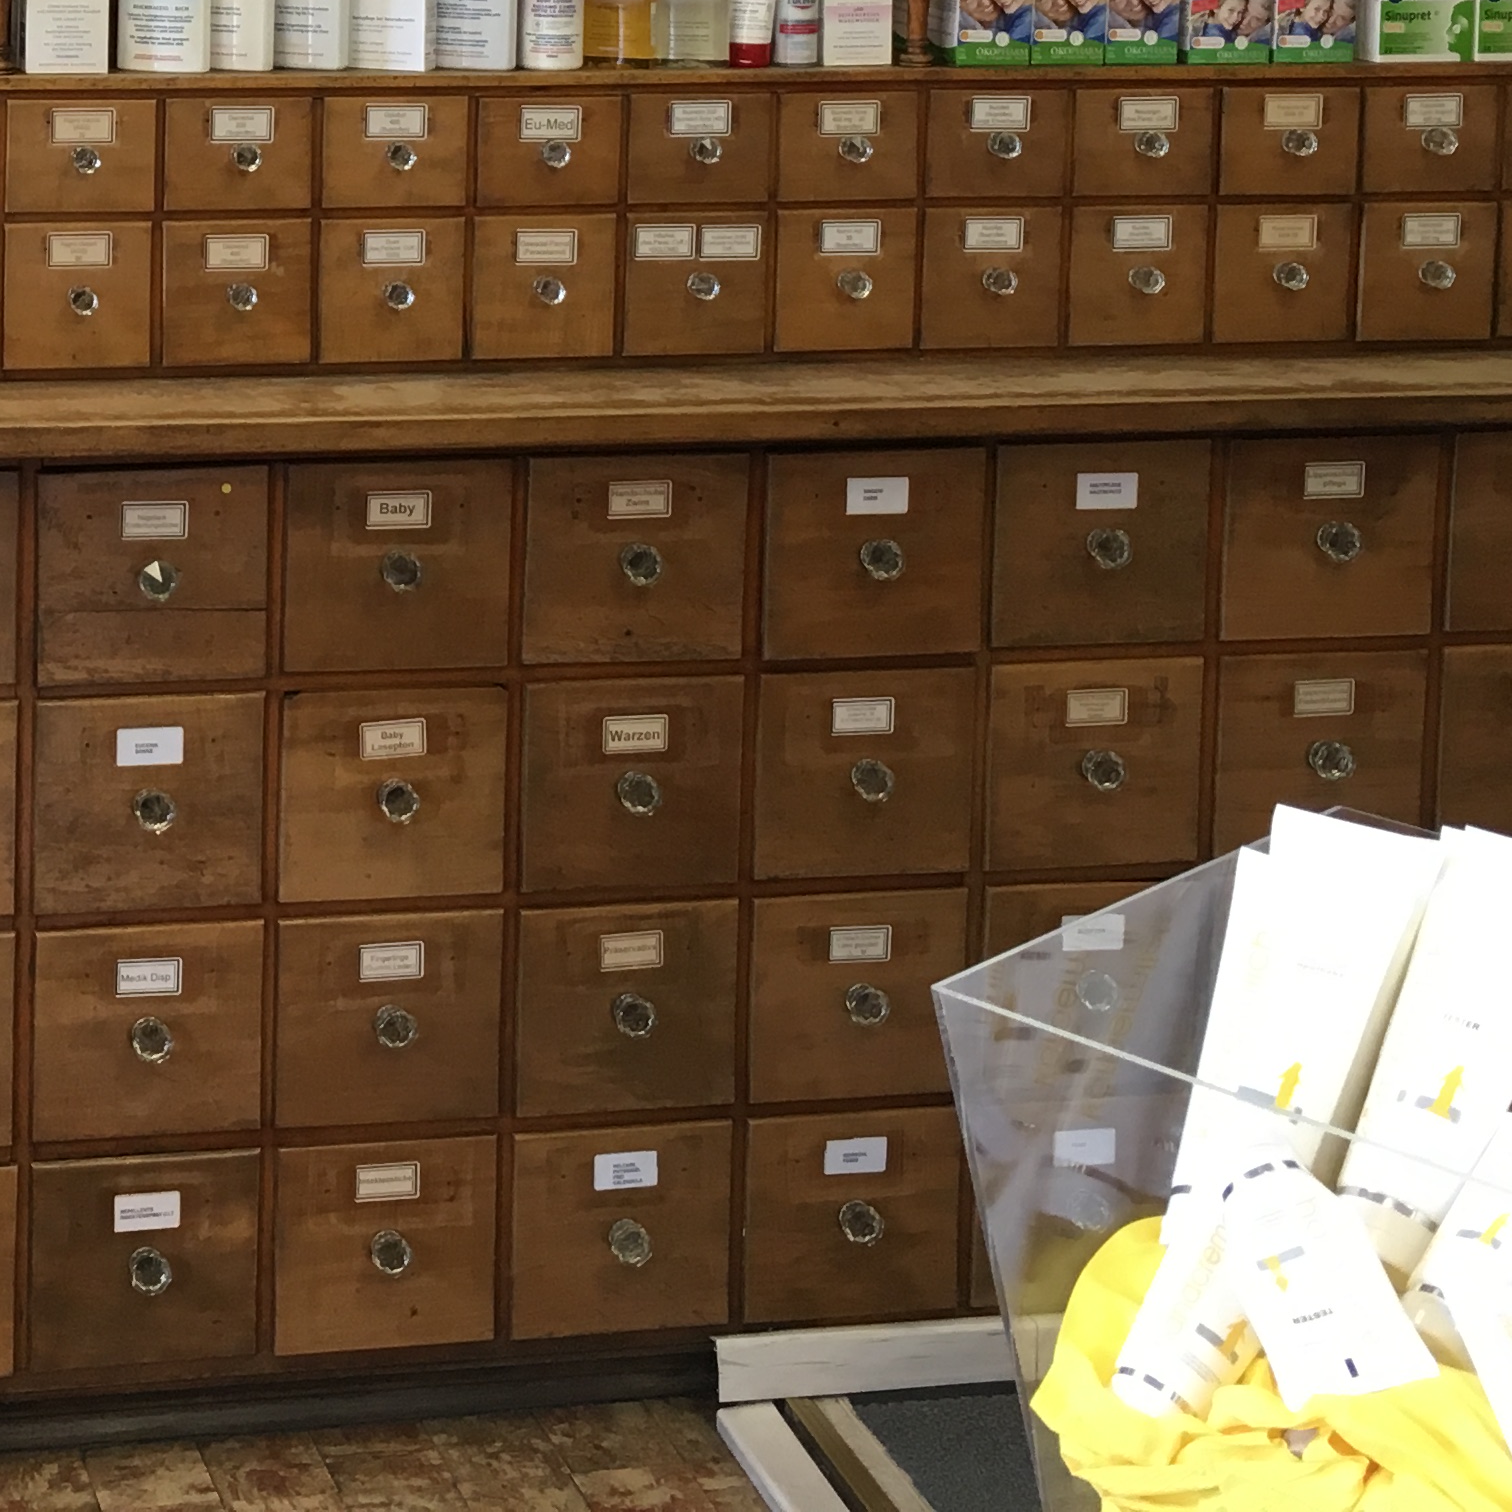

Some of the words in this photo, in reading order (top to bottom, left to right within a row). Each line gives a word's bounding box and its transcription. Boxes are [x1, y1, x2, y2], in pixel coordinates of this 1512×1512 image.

[1385, 10, 1431, 22] Sinupret
[525, 118, 573, 130] Eu-Med
[380, 503, 415, 516] Baby
[381, 731, 404, 741] Baby
[610, 728, 660, 741] Warzen
[121, 974, 147, 982] Medik
[150, 973, 170, 983] Disp
[1292, 1308, 1333, 1324] TESTER
